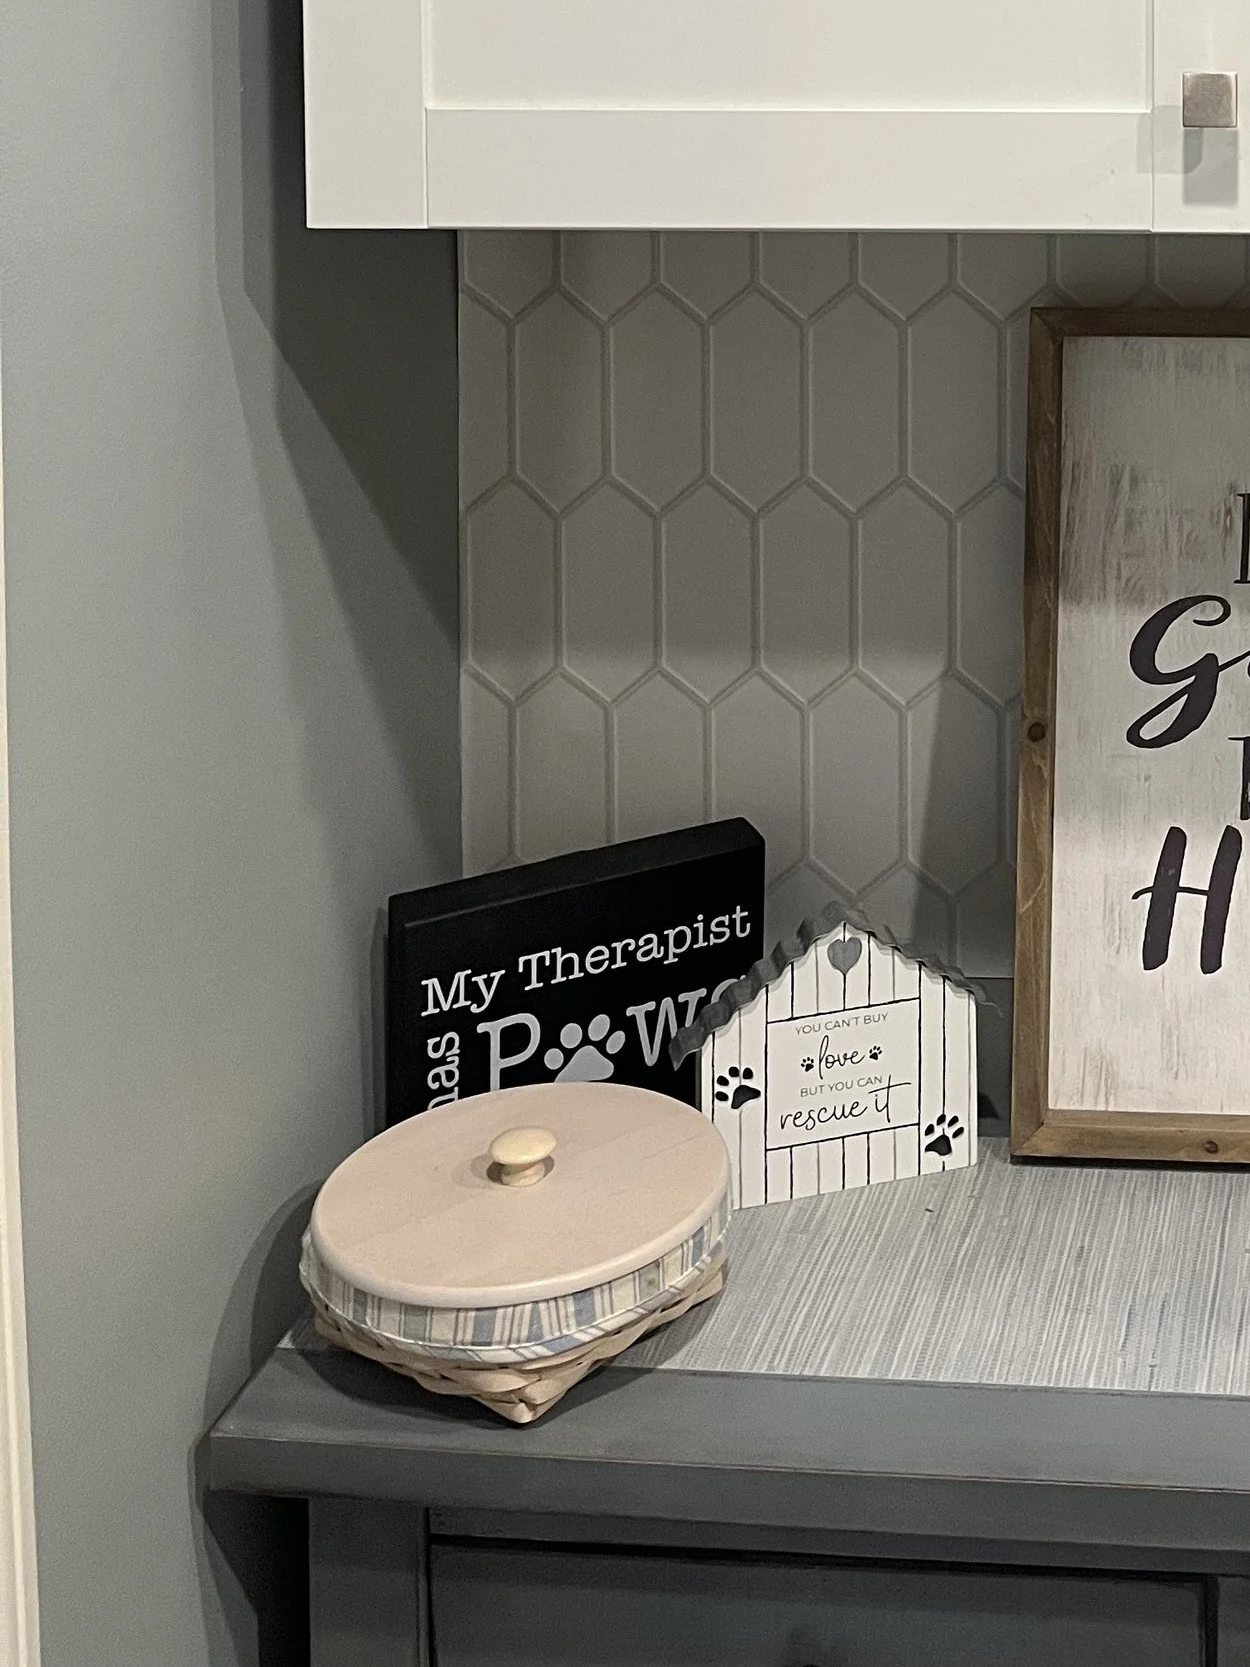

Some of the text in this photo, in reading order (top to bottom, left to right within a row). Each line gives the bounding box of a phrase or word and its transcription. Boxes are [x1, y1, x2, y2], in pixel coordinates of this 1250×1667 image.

[421, 905, 751, 1016] My Therapist
[795, 1013, 888, 1035] YOU CAN'T BUY
[818, 1035, 865, 1080] love
[780, 1074, 911, 1130] rescue it
[800, 1075, 882, 1097] BUT YOU CAN
